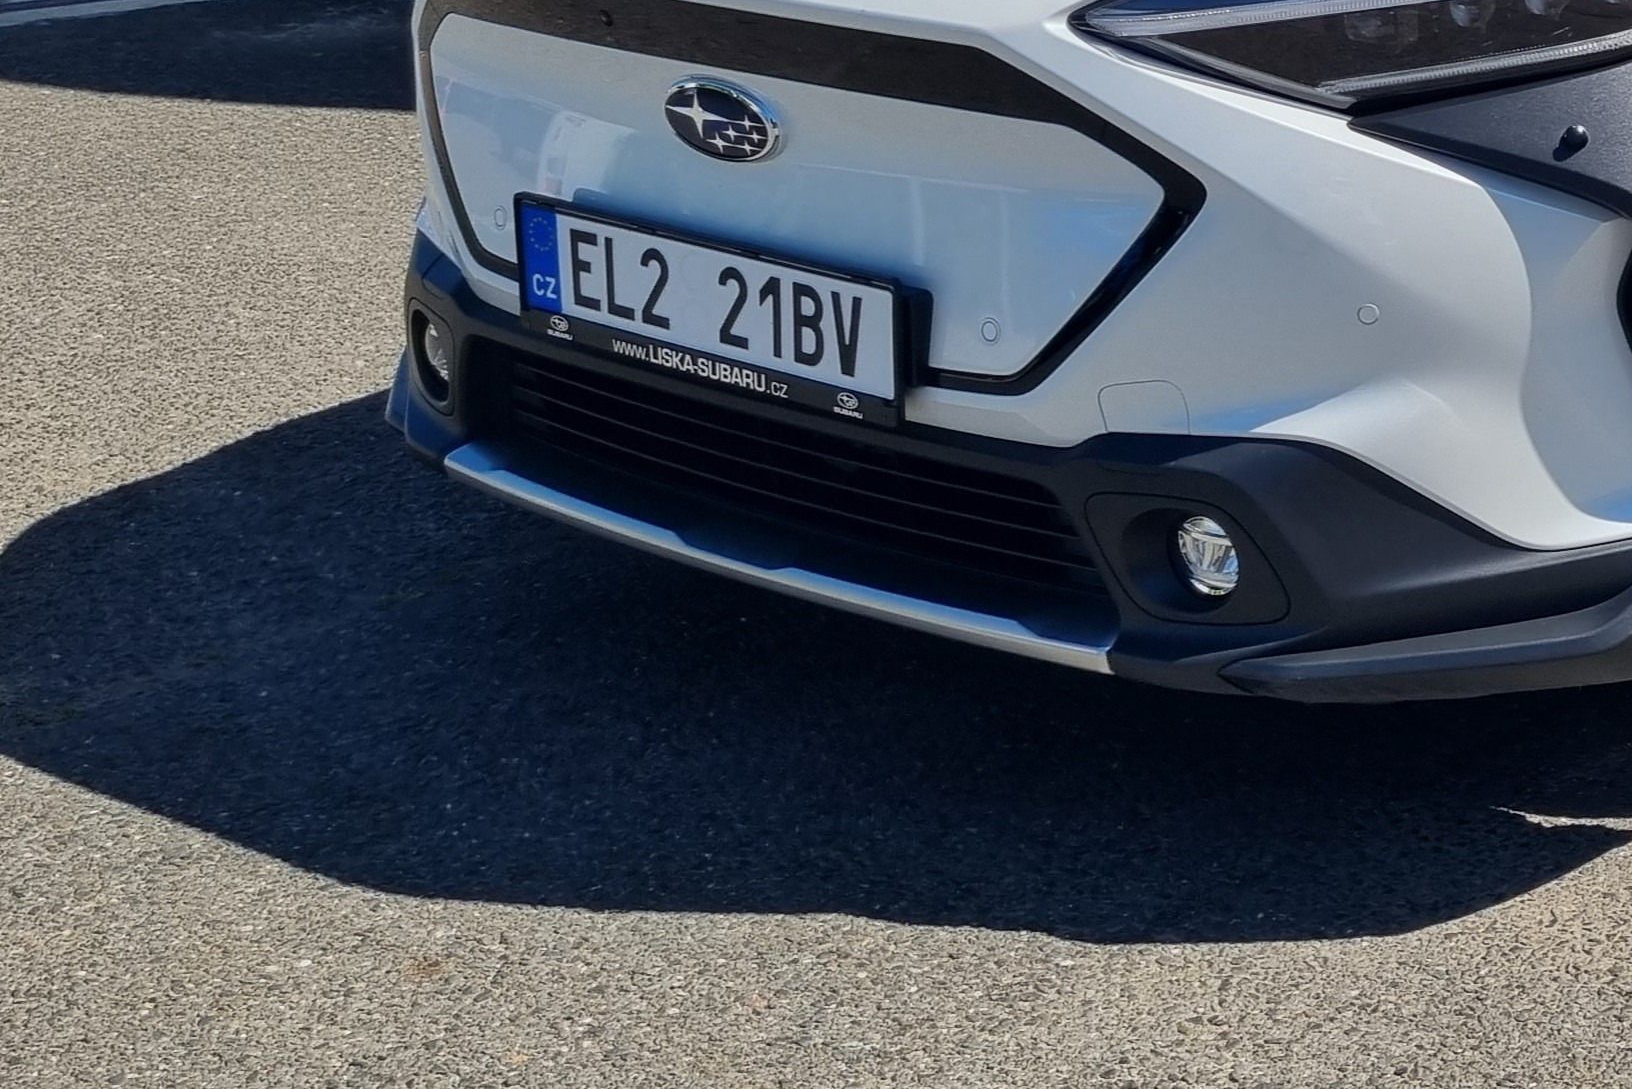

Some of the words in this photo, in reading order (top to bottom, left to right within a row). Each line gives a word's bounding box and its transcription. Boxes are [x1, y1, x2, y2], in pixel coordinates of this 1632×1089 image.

[532, 273, 558, 299] CZ
[569, 228, 671, 330] EL2
[718, 266, 863, 378] 21BV
[611, 338, 789, 399] www.LISKA-SUBARU.cz
